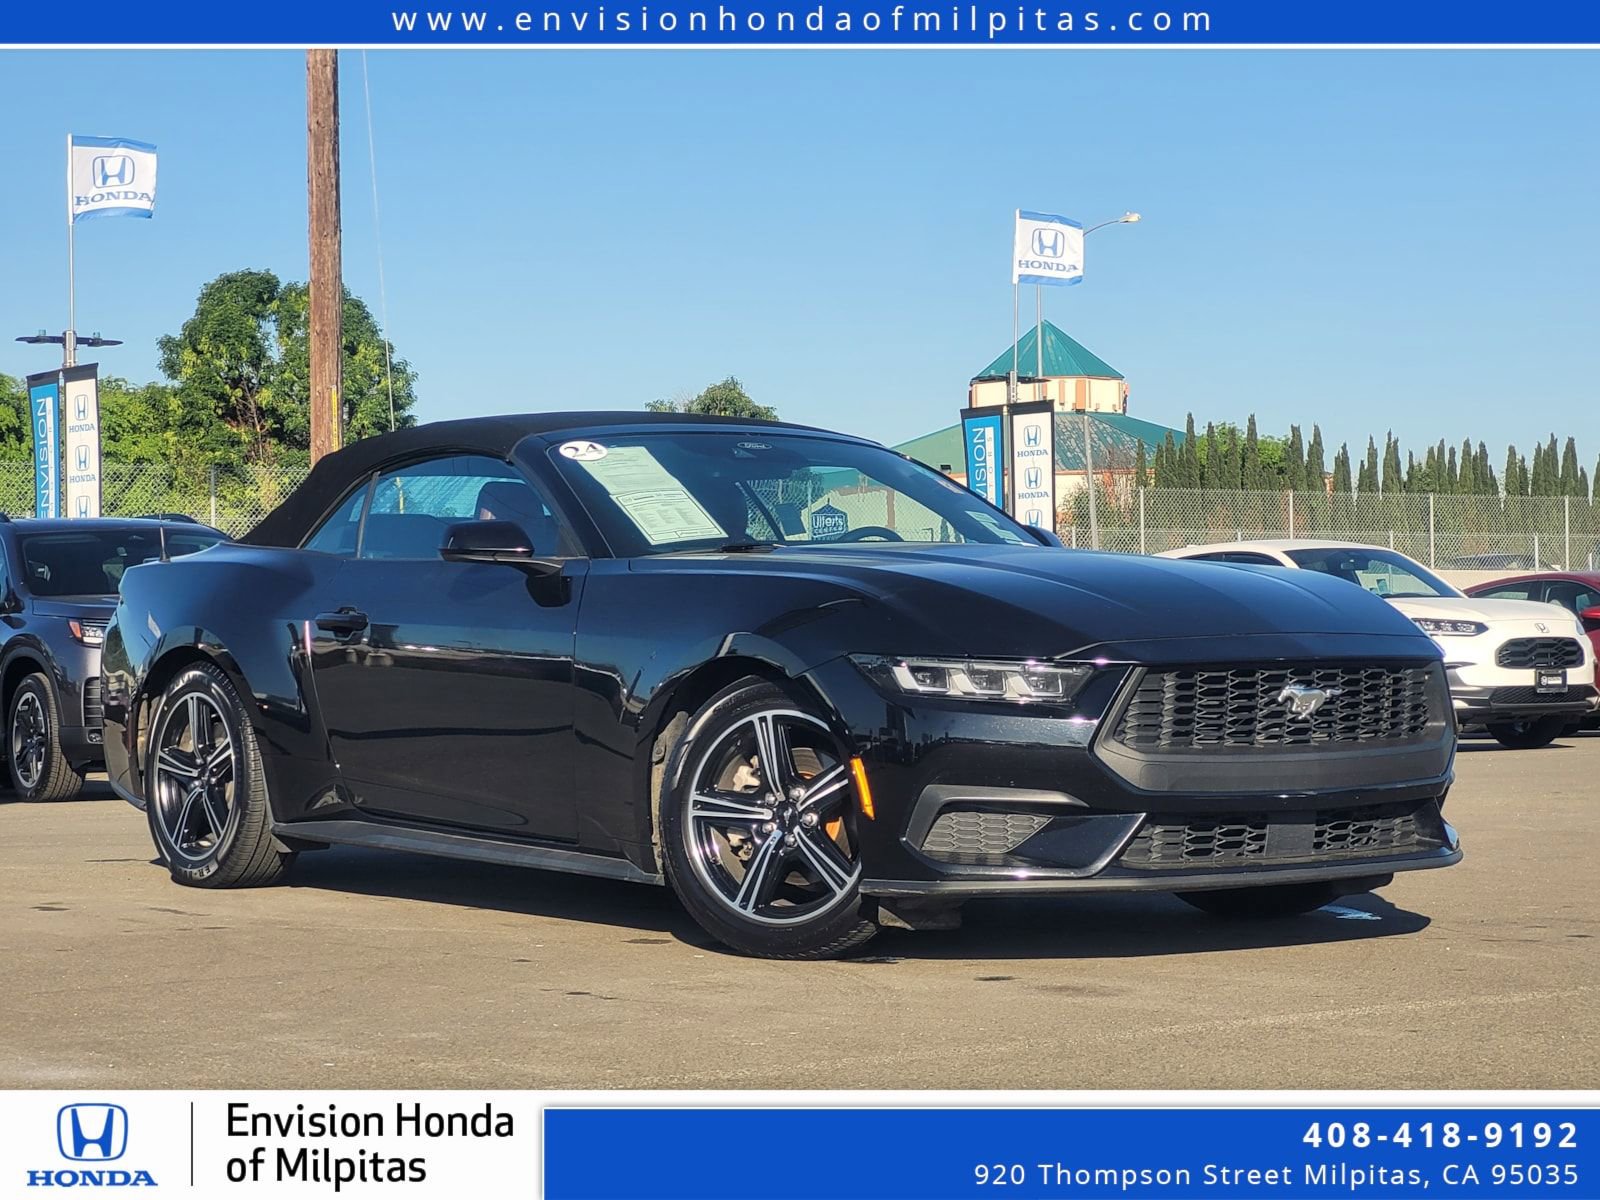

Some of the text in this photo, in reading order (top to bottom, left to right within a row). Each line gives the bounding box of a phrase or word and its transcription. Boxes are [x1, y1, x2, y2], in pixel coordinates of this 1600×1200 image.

[74, 190, 152, 206] HONDA
[1018, 260, 1079, 272] HONDA
[69, 423, 96, 434] HONDA
[1016, 449, 1049, 458] HONDA
[972, 427, 987, 498] VISION
[69, 473, 97, 484] HONDA
[1017, 491, 1050, 500] HONDA
